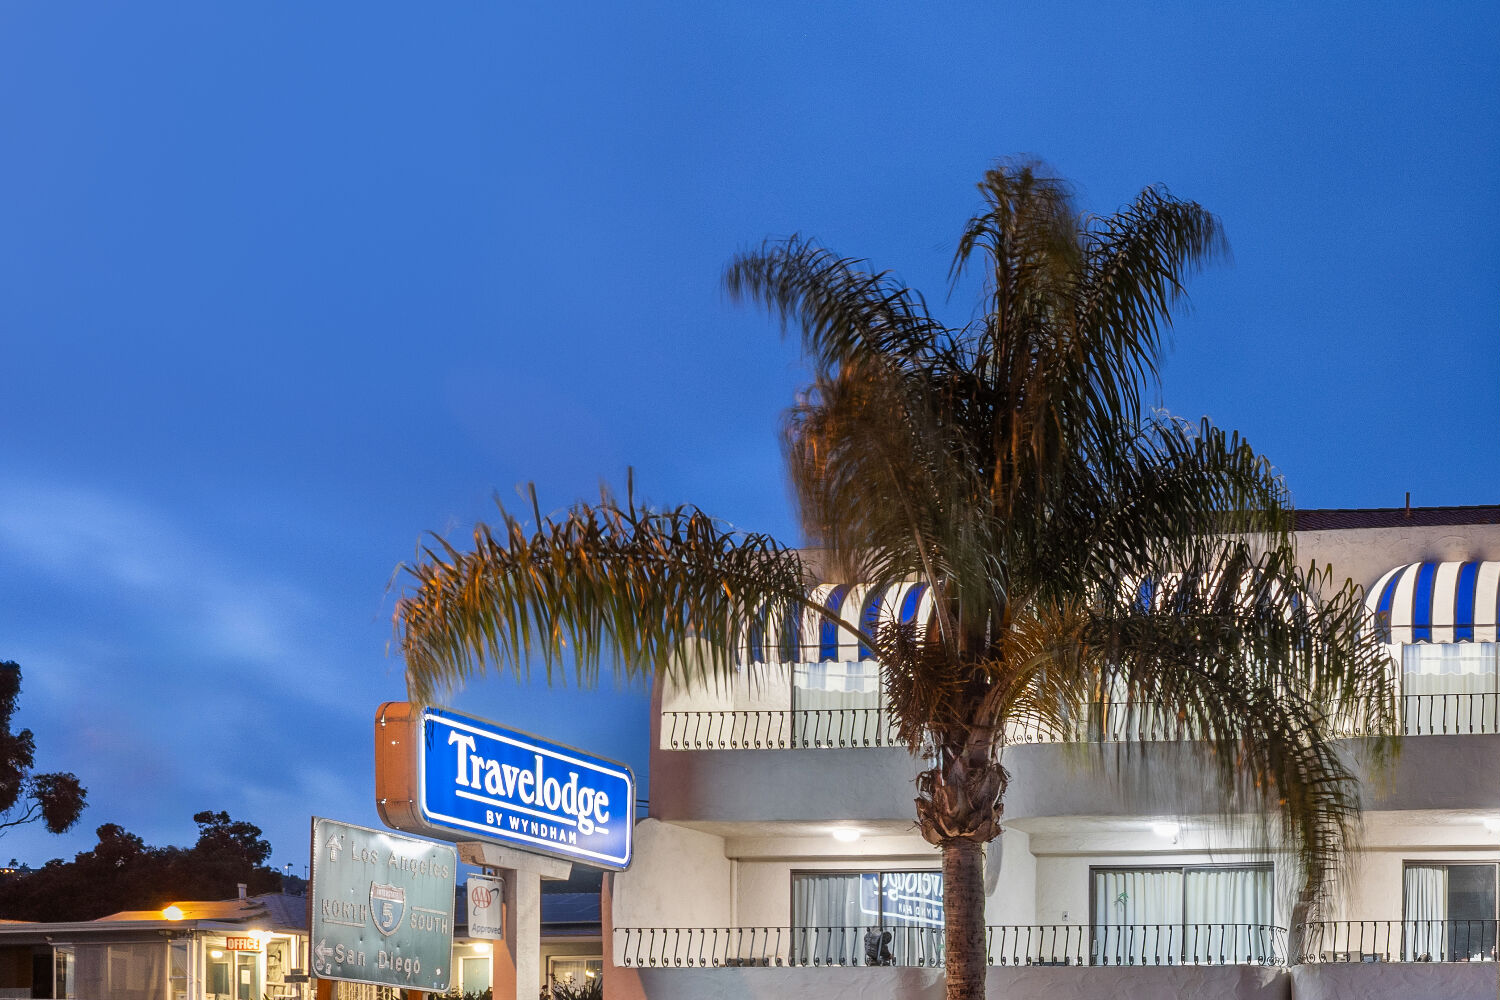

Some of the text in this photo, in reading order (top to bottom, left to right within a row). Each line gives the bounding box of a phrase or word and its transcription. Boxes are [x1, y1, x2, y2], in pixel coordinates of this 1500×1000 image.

[448, 730, 609, 835] Travelodge
[486, 810, 577, 845] BY WYNDHAM
[351, 840, 449, 880] Los Angeles
[321, 899, 367, 921] NORTH
[381, 902, 393, 928] 5
[410, 912, 448, 934] SOUTH
[472, 923, 502, 935] Approved
[227, 938, 259, 950] OFFICE
[334, 943, 421, 979] San Diego
